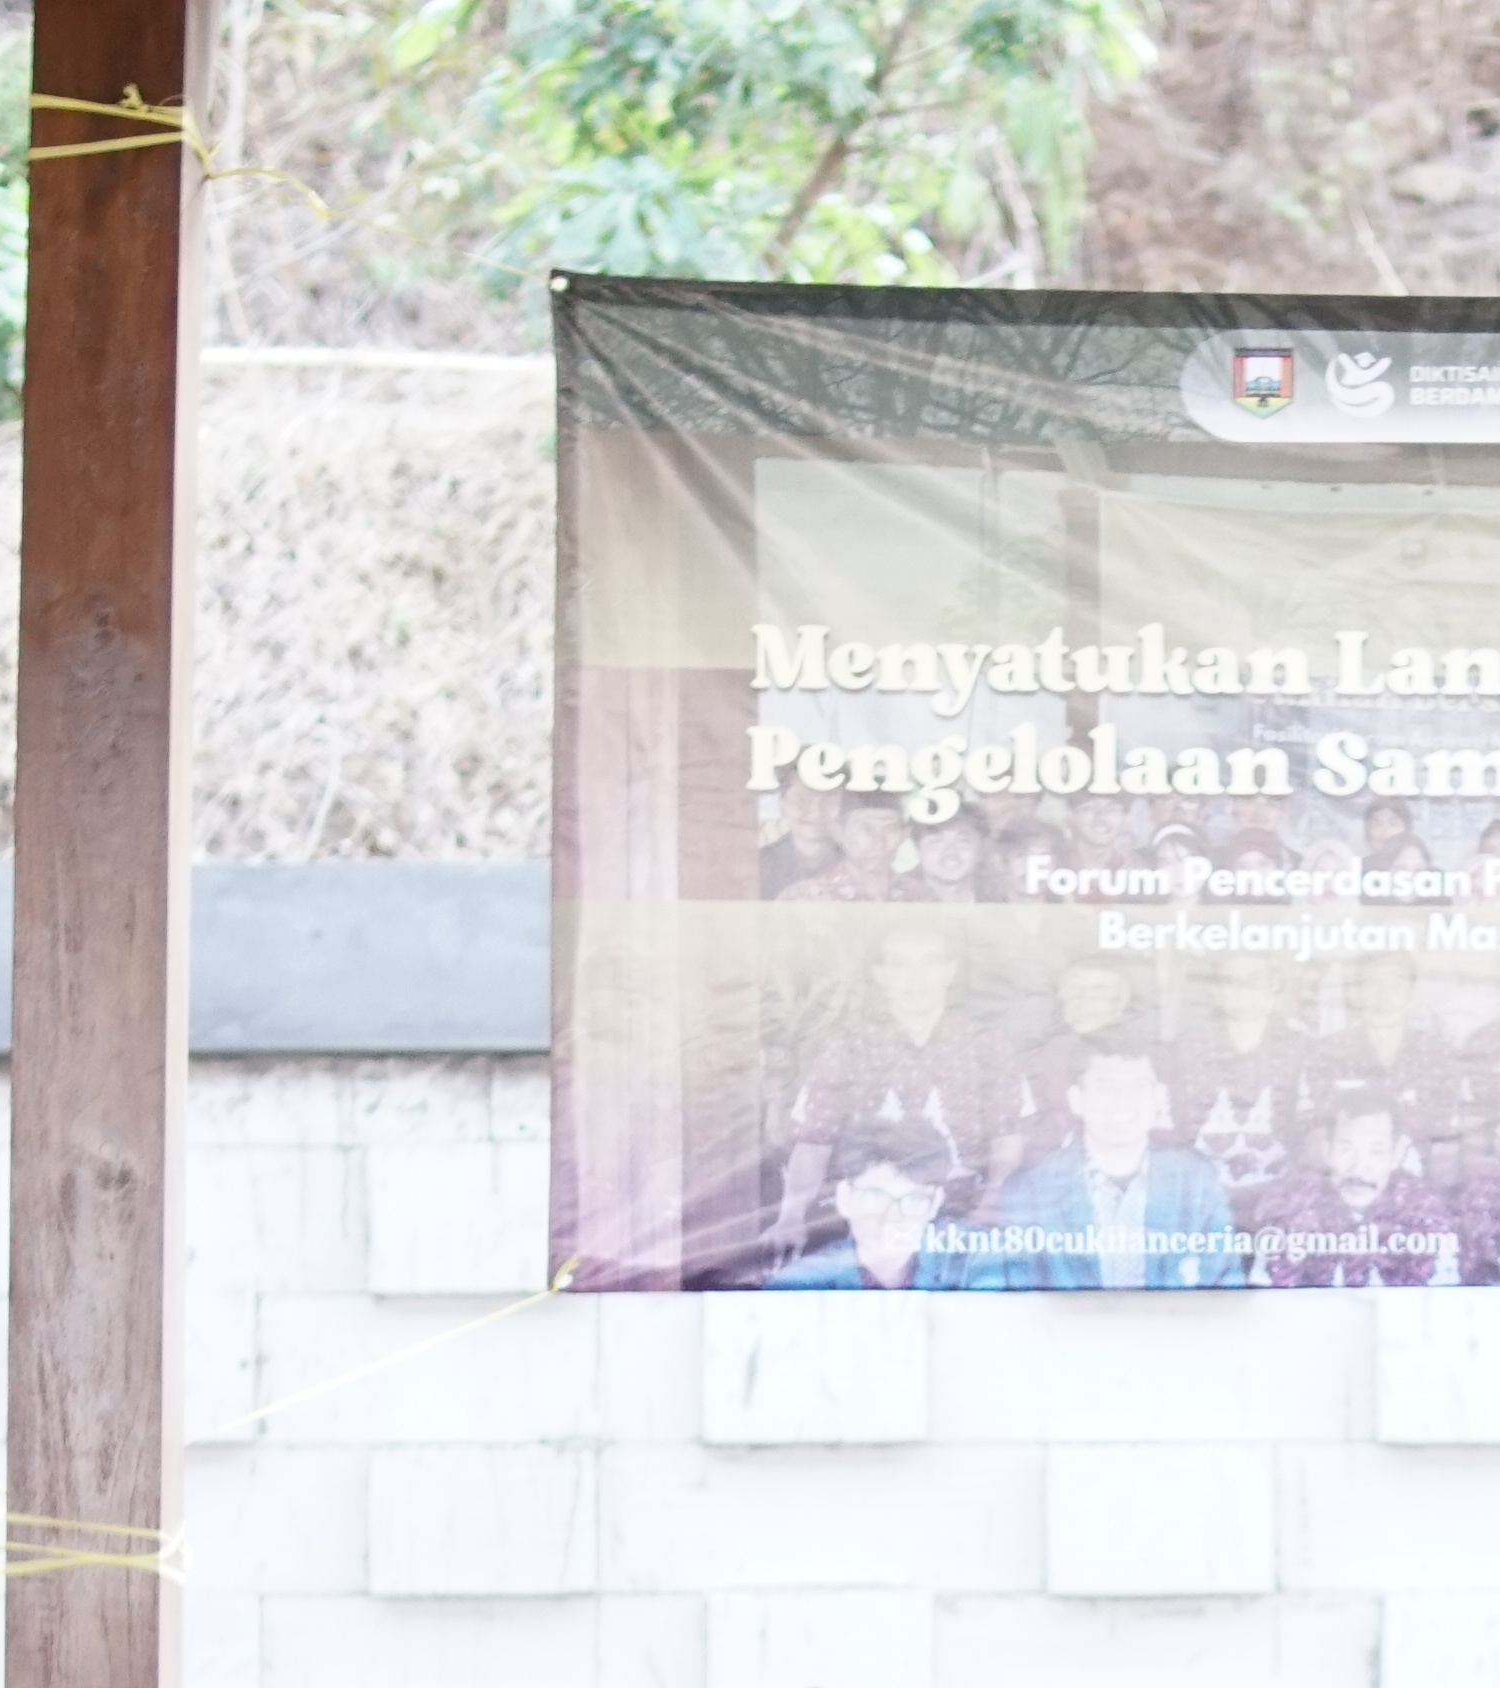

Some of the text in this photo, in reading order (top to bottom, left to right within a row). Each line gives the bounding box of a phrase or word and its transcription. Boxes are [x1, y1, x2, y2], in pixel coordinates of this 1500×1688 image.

[750, 623, 1311, 717] Menyatukan
[746, 723, 1294, 825] Pengelolaan
[1025, 856, 1170, 897] Forum
[1184, 856, 1472, 898] Pencerdasan
[1100, 914, 1414, 963] Berkelanjutan
[924, 1225, 1459, 1259] kknt80cukilanceria@gmail.com
